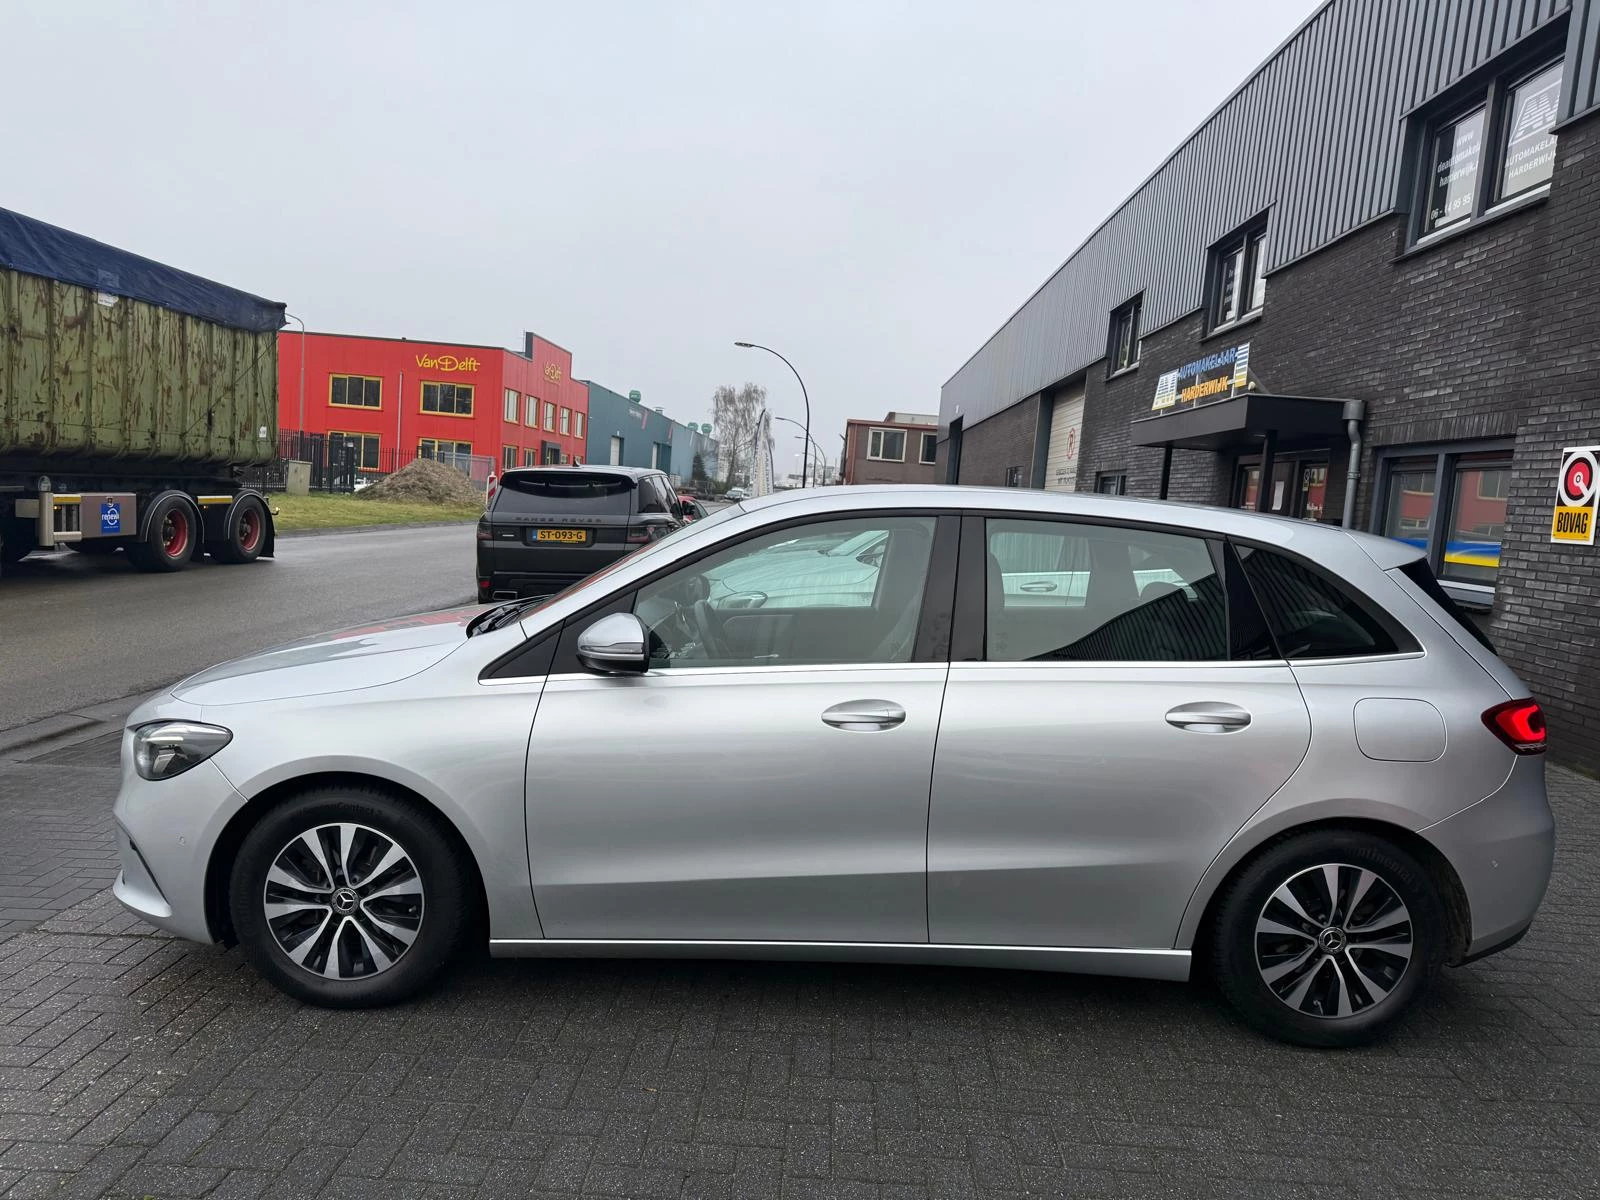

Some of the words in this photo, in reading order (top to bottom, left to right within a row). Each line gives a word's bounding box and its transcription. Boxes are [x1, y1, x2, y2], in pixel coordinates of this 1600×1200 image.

[1504, 136, 1558, 168] AUTOMAKELA
[1178, 347, 1238, 380] AUTOMAKELAAR
[1181, 375, 1229, 403] HARDERWIJK
[540, 530, 582, 540] ST-093-G
[1556, 511, 1589, 534] BOVAG
